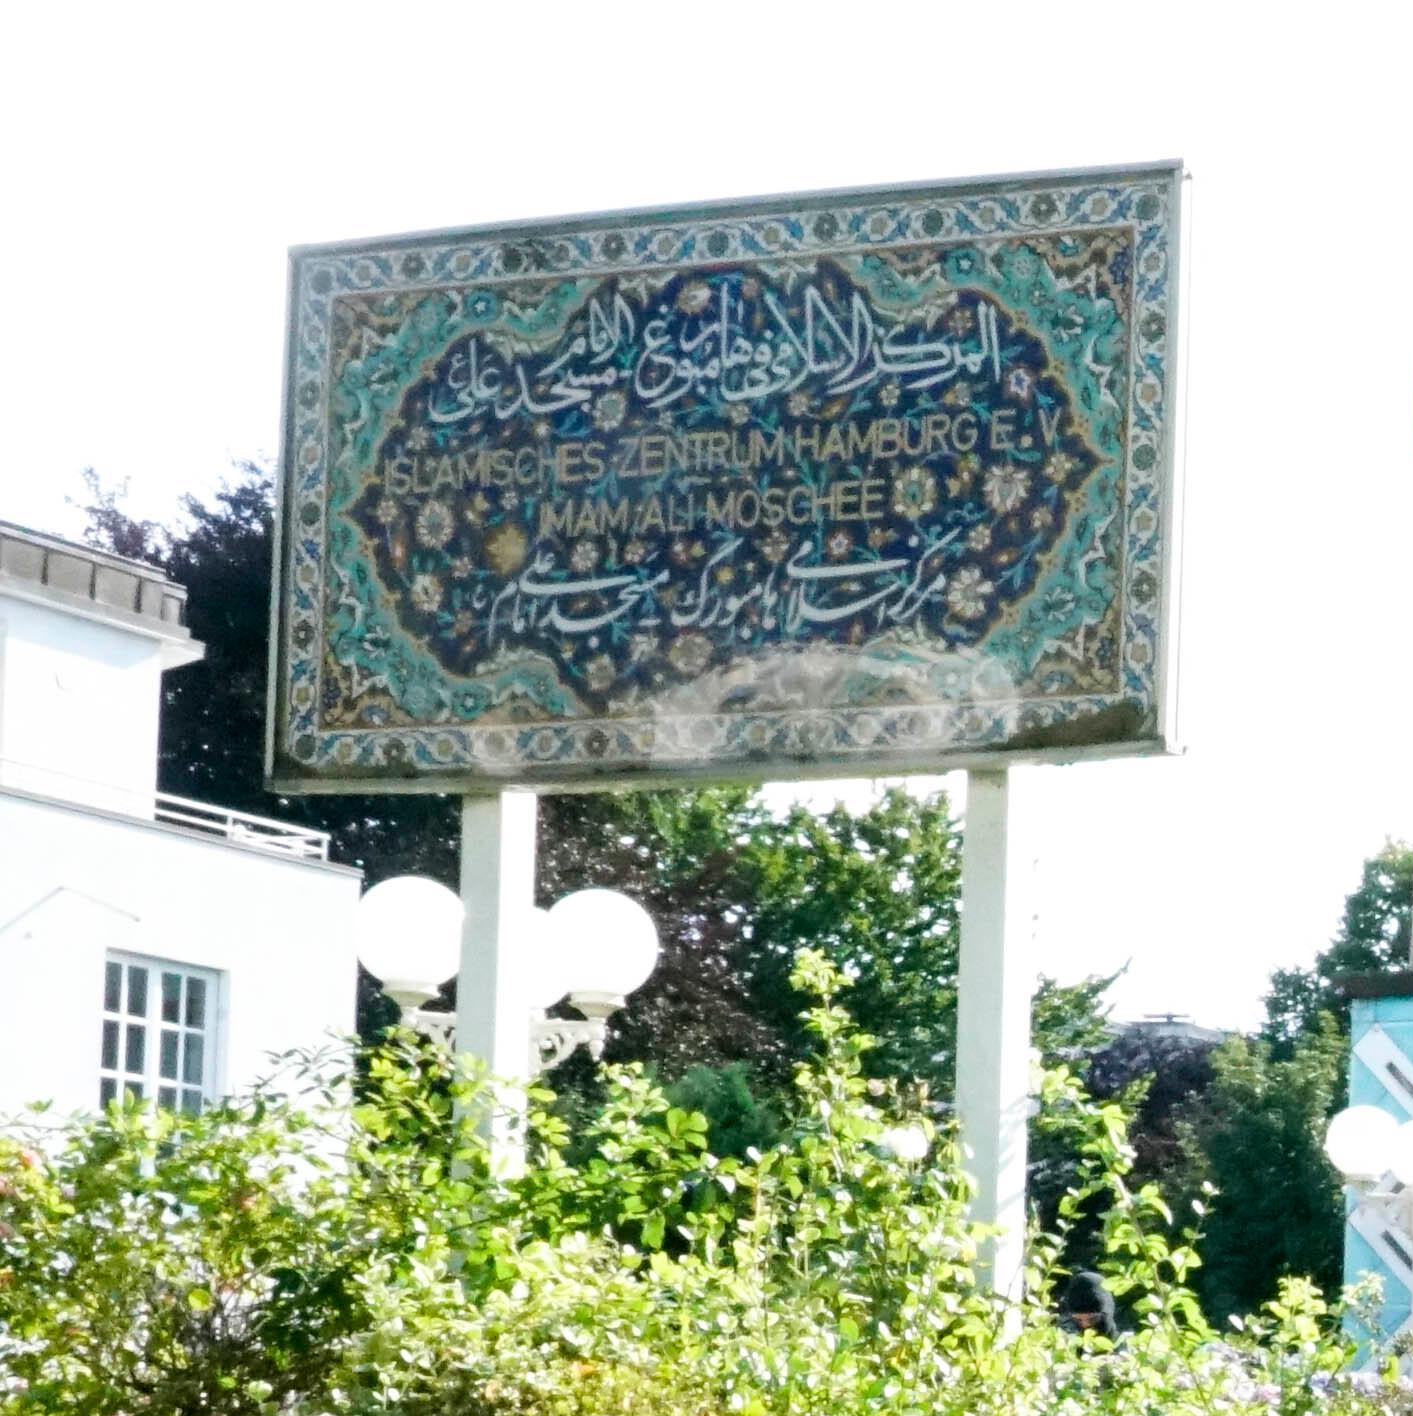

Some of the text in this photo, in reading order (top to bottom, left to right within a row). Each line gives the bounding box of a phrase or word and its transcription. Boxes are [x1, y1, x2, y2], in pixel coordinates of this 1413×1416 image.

[384, 441, 606, 494] ISLAMISCHES
[617, 426, 785, 479] ZENTRUM
[795, 411, 979, 463] HAMBURG
[704, 478, 886, 529] MOSCHEE
